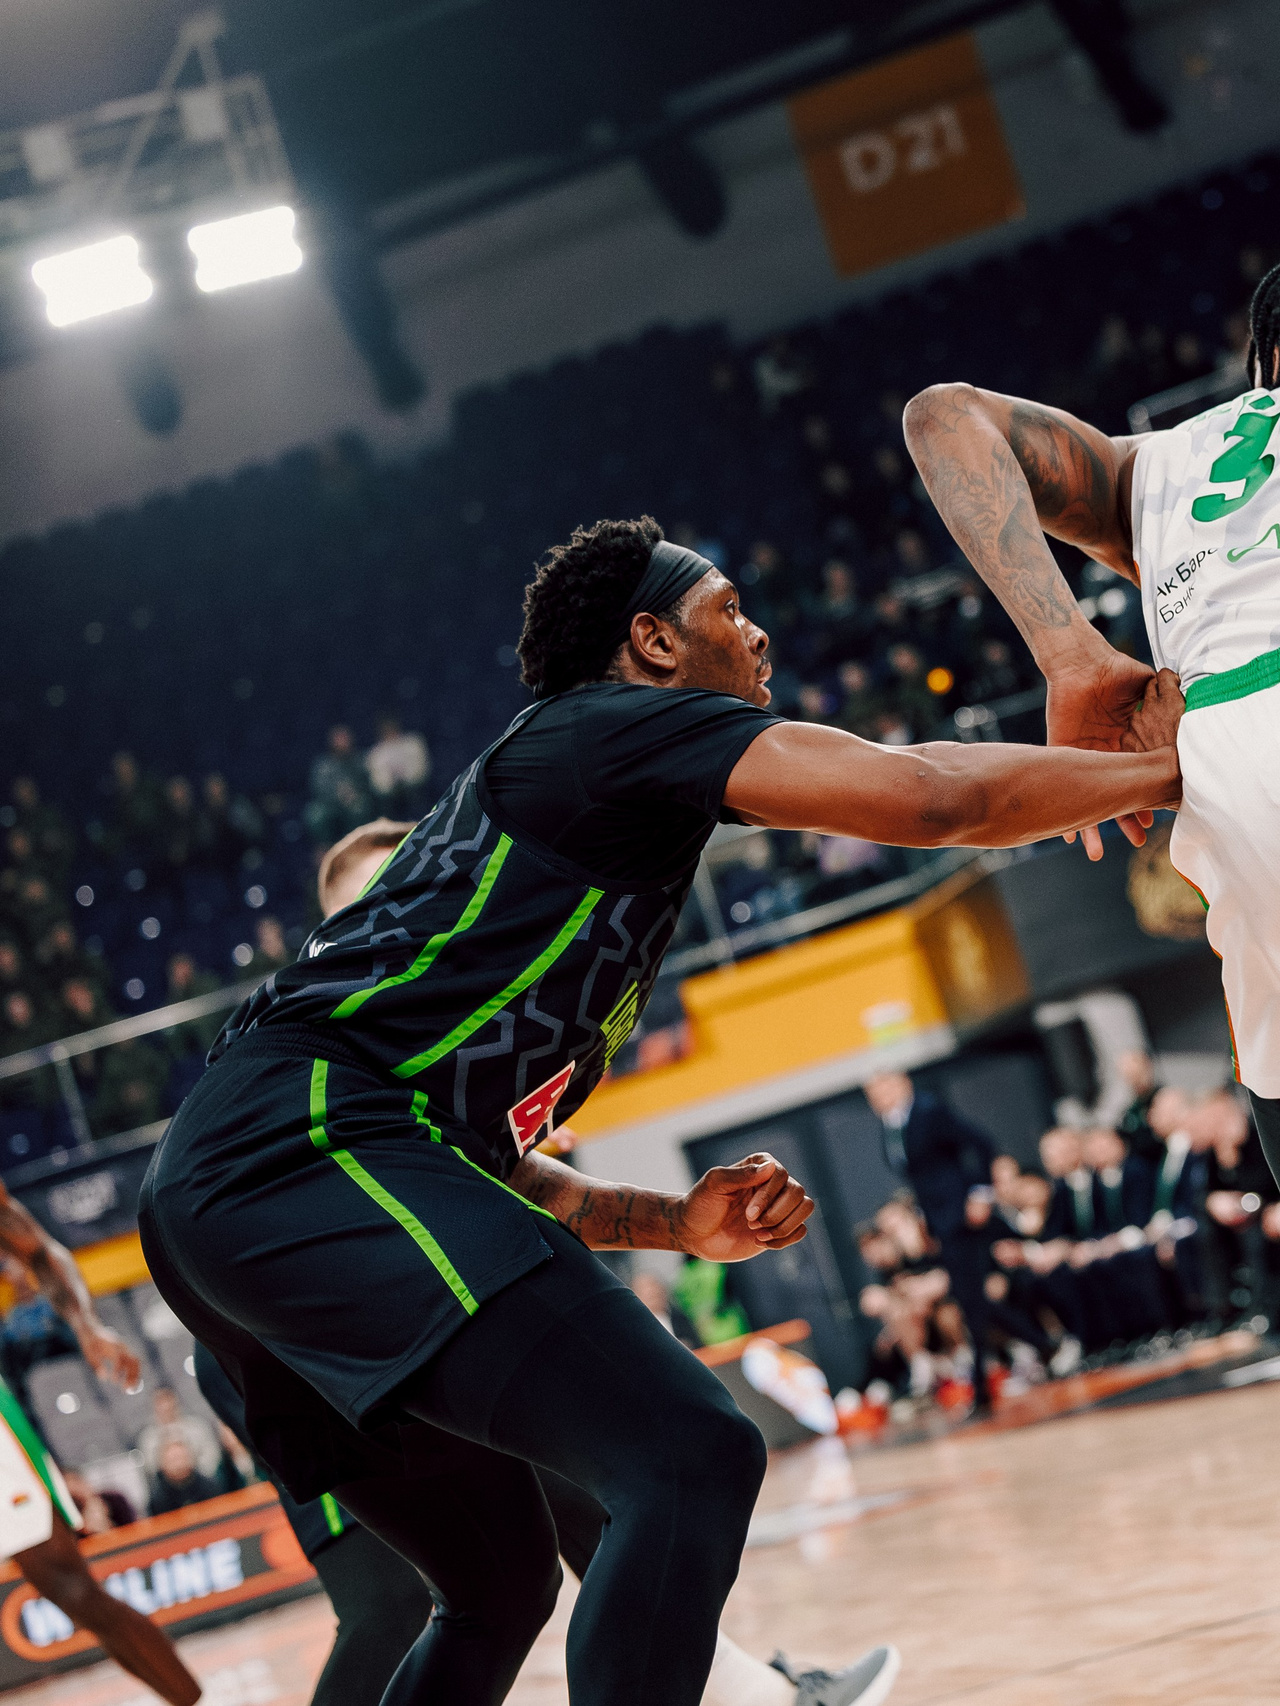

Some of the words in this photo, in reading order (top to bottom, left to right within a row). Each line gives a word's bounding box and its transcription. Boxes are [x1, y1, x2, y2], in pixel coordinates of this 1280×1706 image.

[838, 103, 966, 194] D21
[1158, 580, 1196, 624] Банк
[20, 1537, 245, 1648] WLINE
